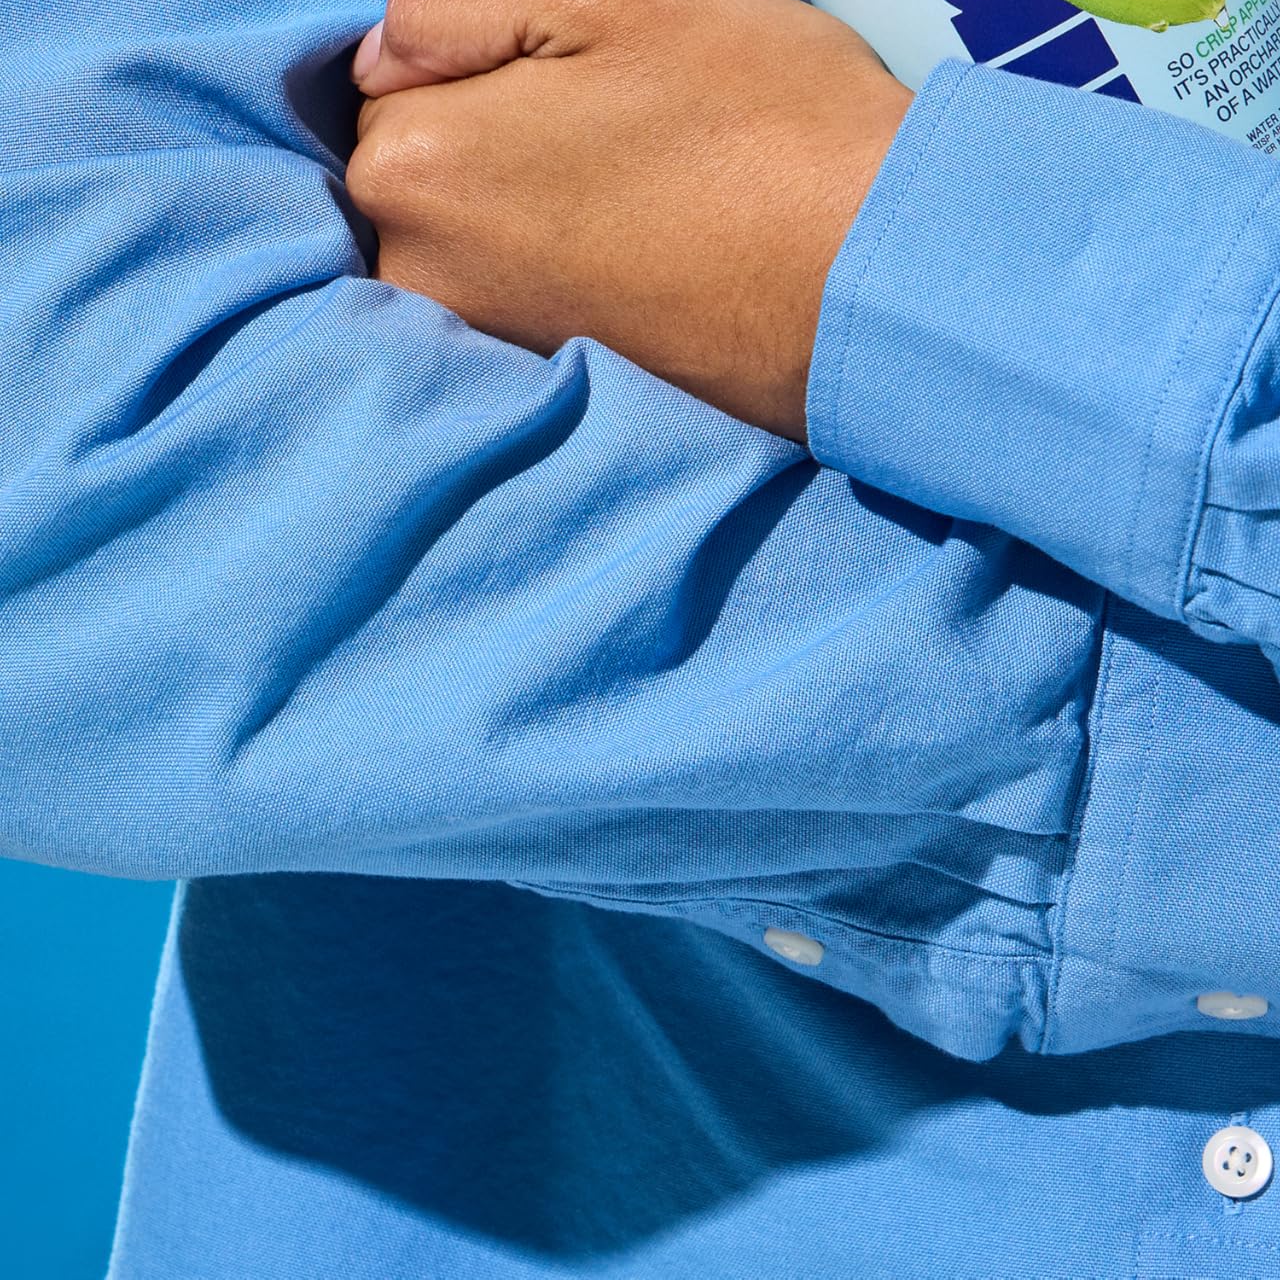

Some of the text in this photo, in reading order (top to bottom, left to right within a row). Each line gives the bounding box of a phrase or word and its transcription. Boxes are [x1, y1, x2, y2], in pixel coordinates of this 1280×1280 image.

[1167, 52, 1194, 77] SO
[1196, 16, 1237, 58] CRISP
[1173, 69, 1208, 100] IT'S
[1203, 80, 1229, 107] AN
[1217, 96, 1239, 122] OF
[1242, 88, 1256, 106] A
[1246, 113, 1279, 142] WATER
[1252, 134, 1270, 150] RISP
